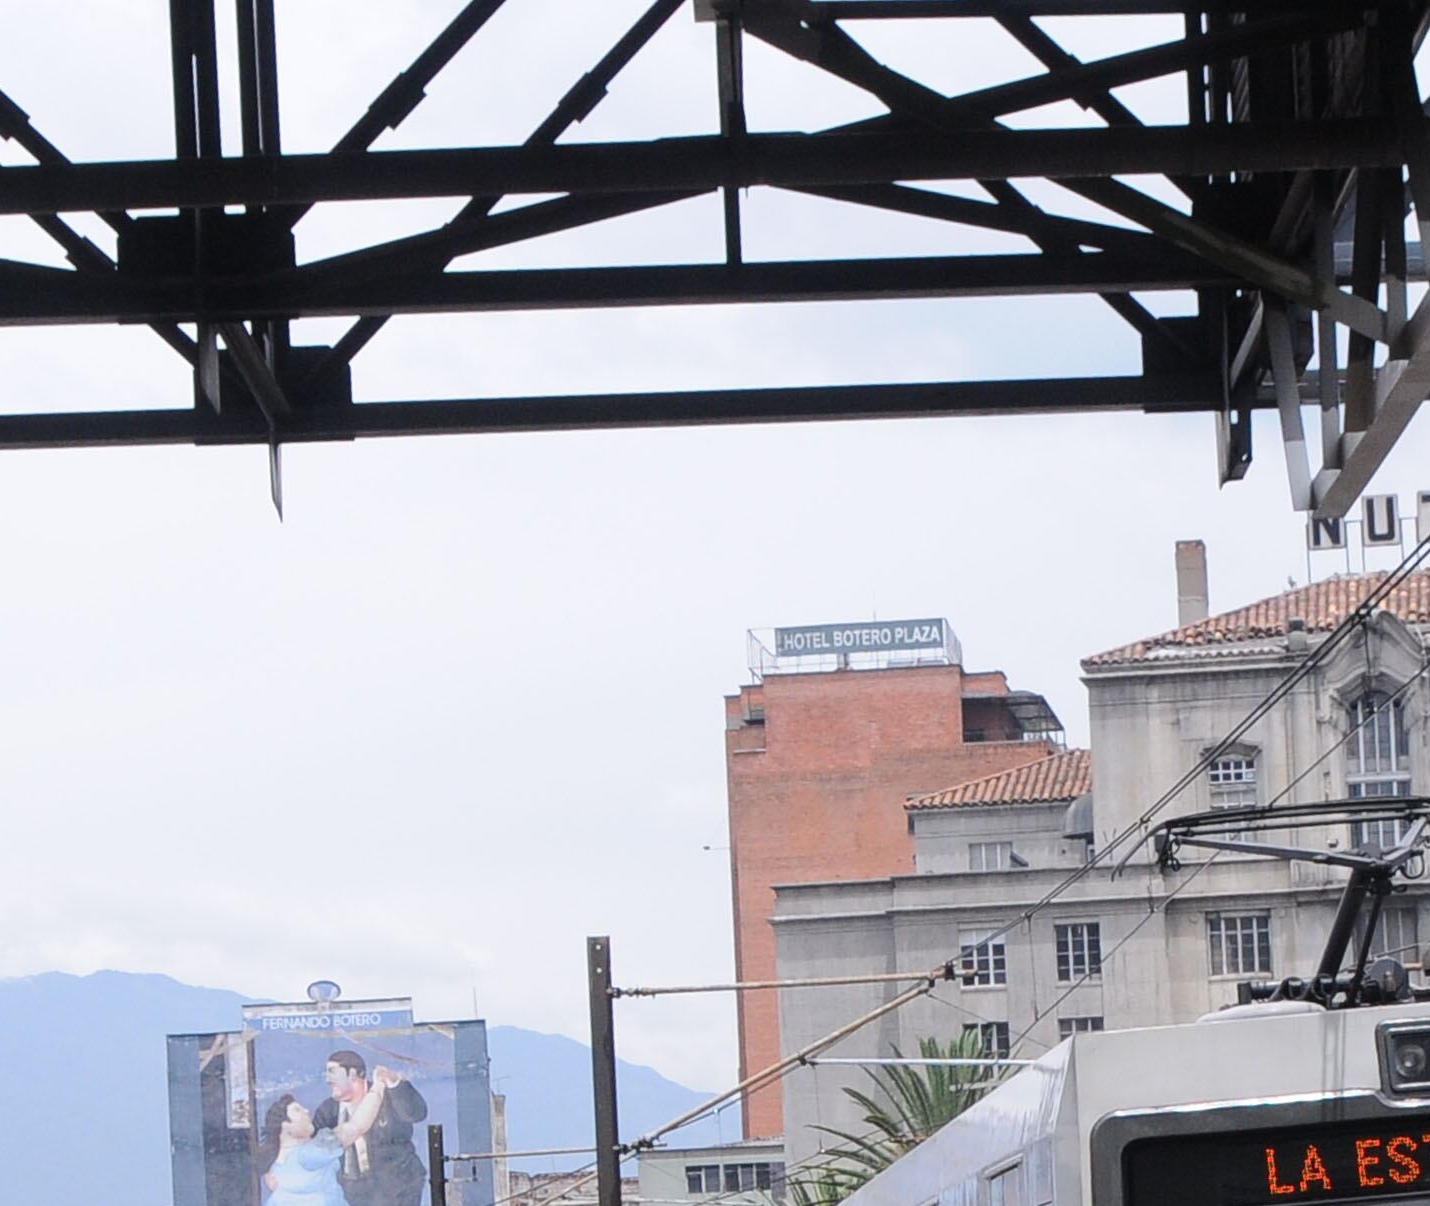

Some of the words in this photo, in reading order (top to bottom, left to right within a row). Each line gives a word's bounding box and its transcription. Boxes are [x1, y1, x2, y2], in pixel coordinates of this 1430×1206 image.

[783, 633, 829, 650] HOTEL
[833, 628, 891, 647] BOTERO
[895, 625, 940, 644] PLAZA
[262, 1016, 330, 1030] FERNANDO
[333, 1013, 381, 1028] BOTERO
[1266, 1144, 1332, 1195] LA
